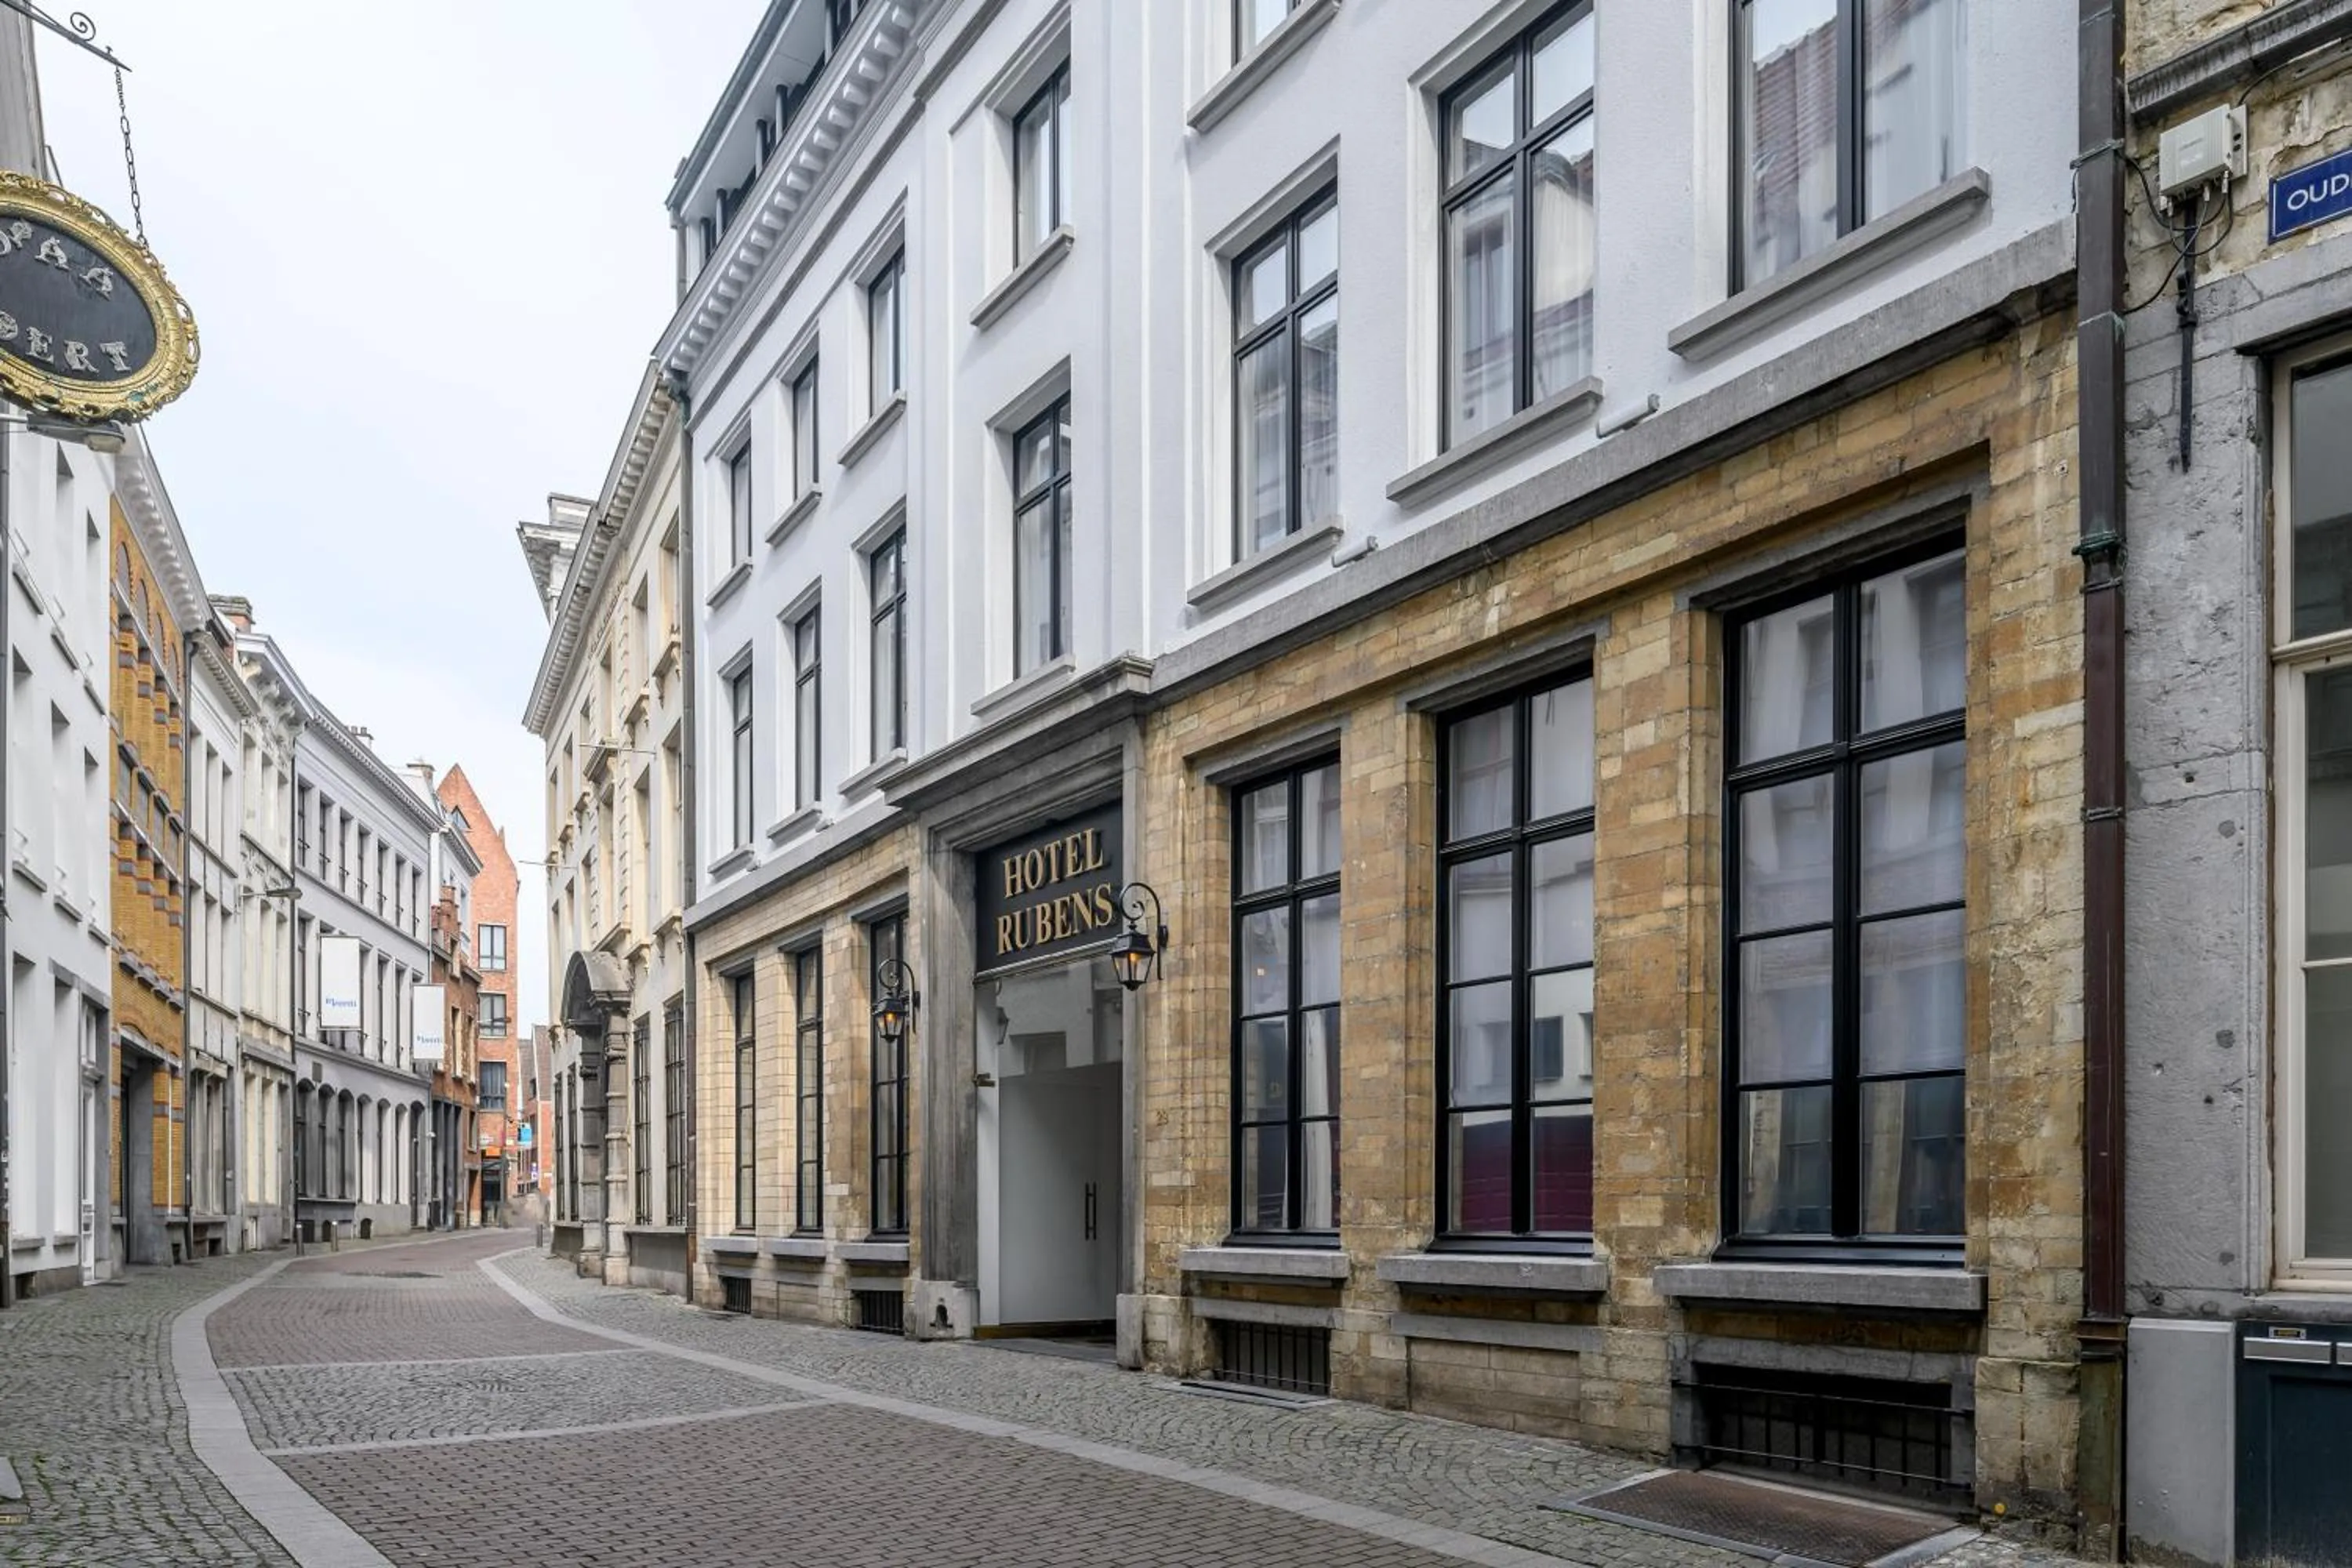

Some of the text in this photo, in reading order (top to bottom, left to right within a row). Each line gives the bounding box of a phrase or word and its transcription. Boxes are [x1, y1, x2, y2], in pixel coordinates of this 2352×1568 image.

[2287, 171, 2352, 211] OUD
[1003, 827, 1104, 899] HOTEL
[996, 882, 1113, 956] RUBENS
